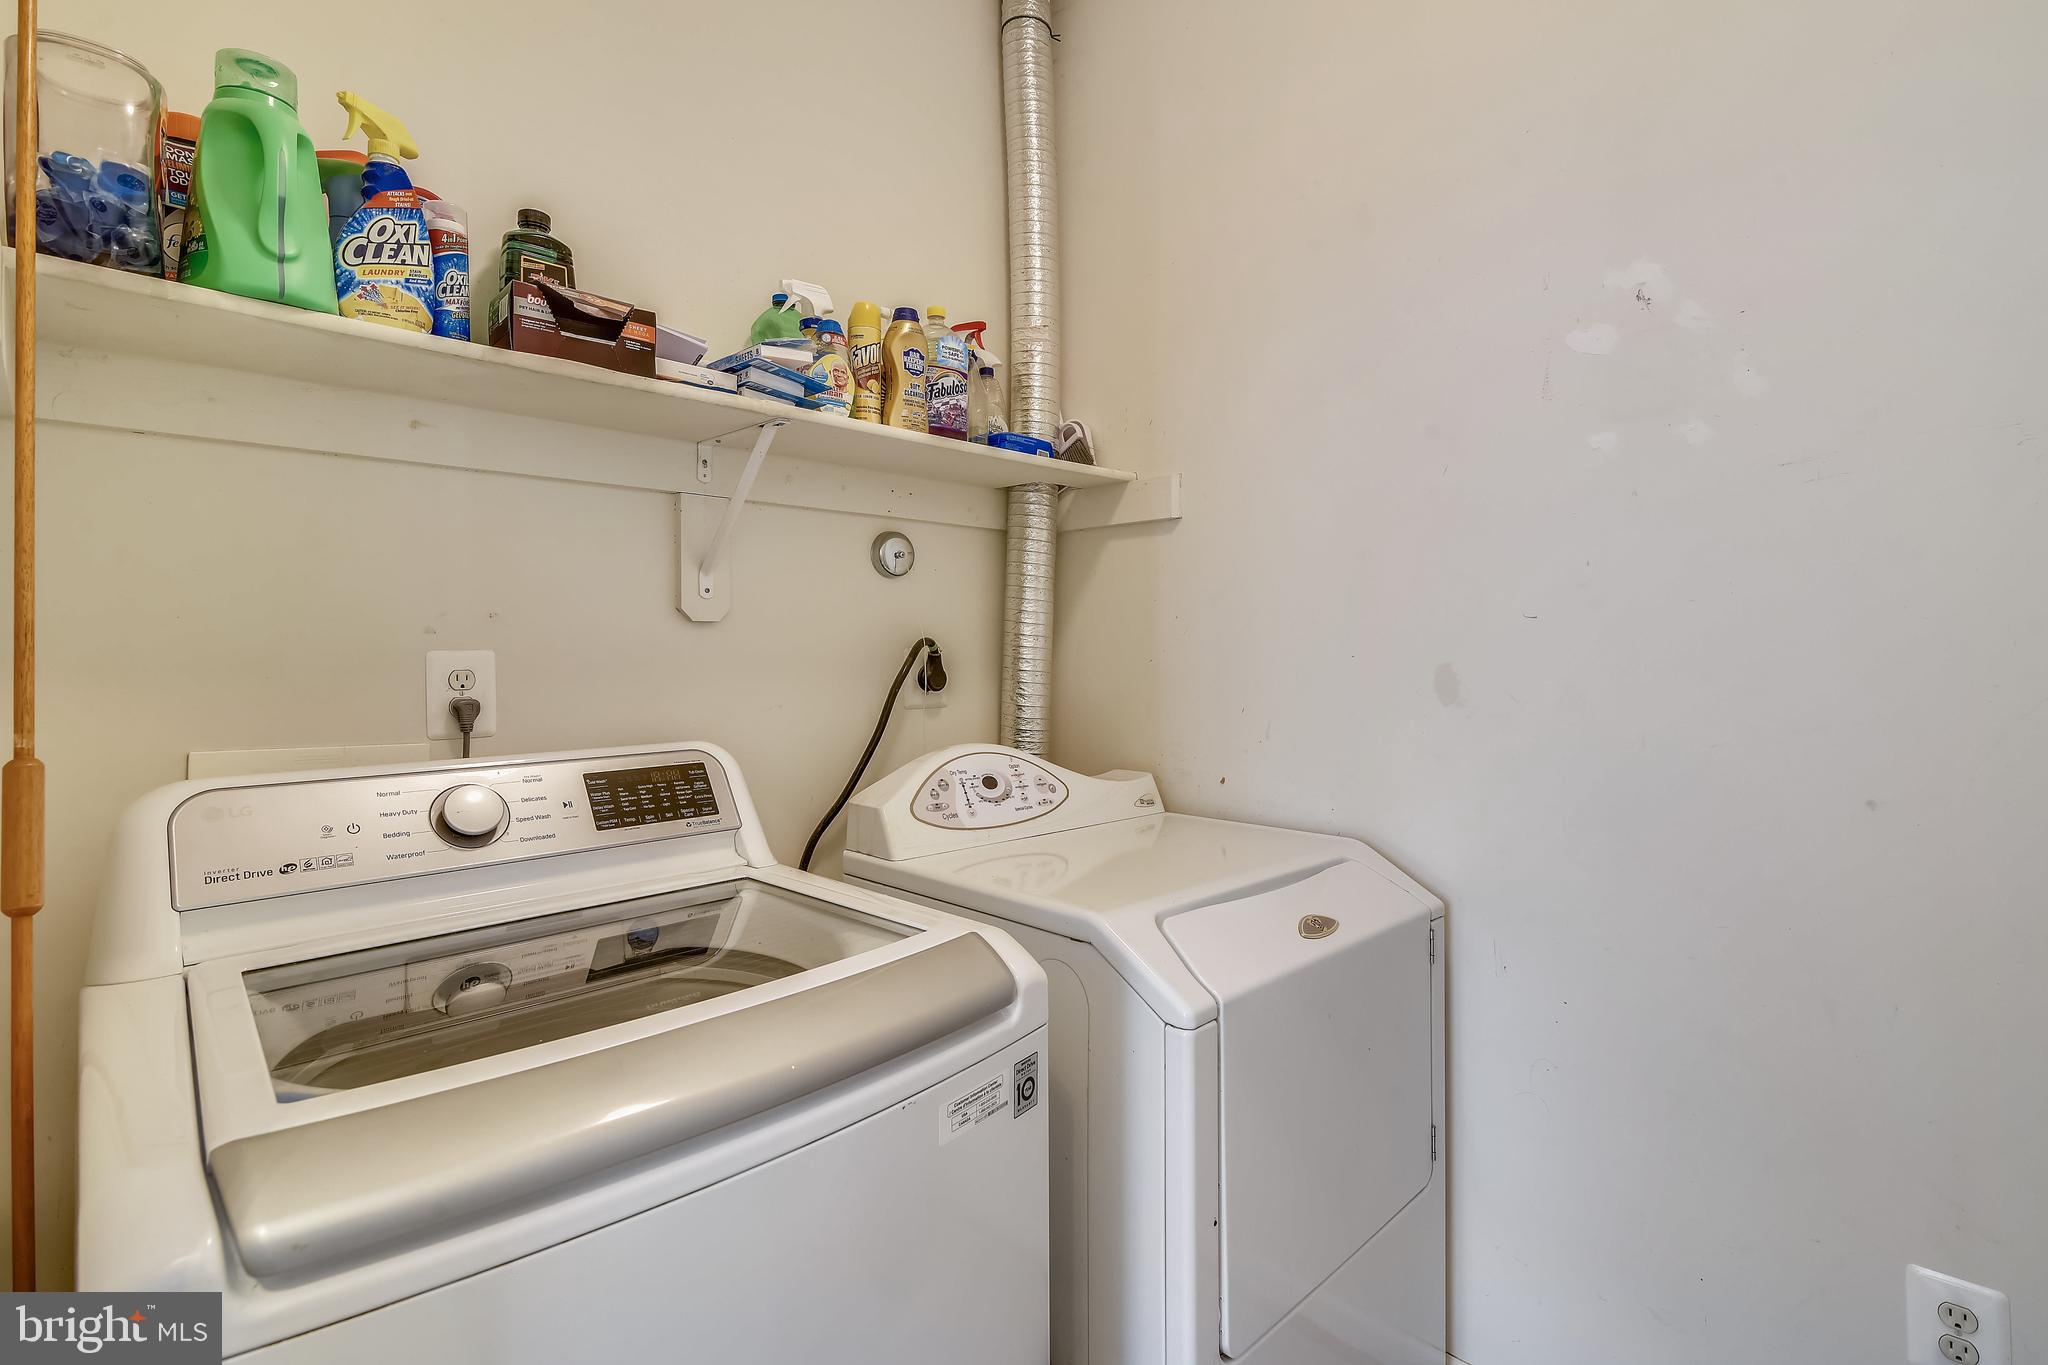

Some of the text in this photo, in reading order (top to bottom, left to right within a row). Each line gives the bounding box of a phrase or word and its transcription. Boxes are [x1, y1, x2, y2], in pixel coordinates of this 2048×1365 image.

[367, 217, 418, 244] OXI
[342, 236, 431, 267] CLEAN
[362, 268, 406, 276] LAUNDRY
[927, 380, 968, 401] Fabuloso
[376, 790, 401, 798] Normal
[520, 795, 548, 803] Delicates
[228, 806, 254, 819] LG
[379, 808, 418, 819] Heavy Duty
[942, 812, 959, 821] Cycles
[515, 815, 534, 823] Speed
[382, 830, 411, 840] Bedding
[519, 833, 557, 843] Downloaded
[385, 850, 426, 862] Waterproof
[204, 873, 241, 885] Direct
[243, 867, 274, 880] Drive
[1017, 1076, 1035, 1106] 10
